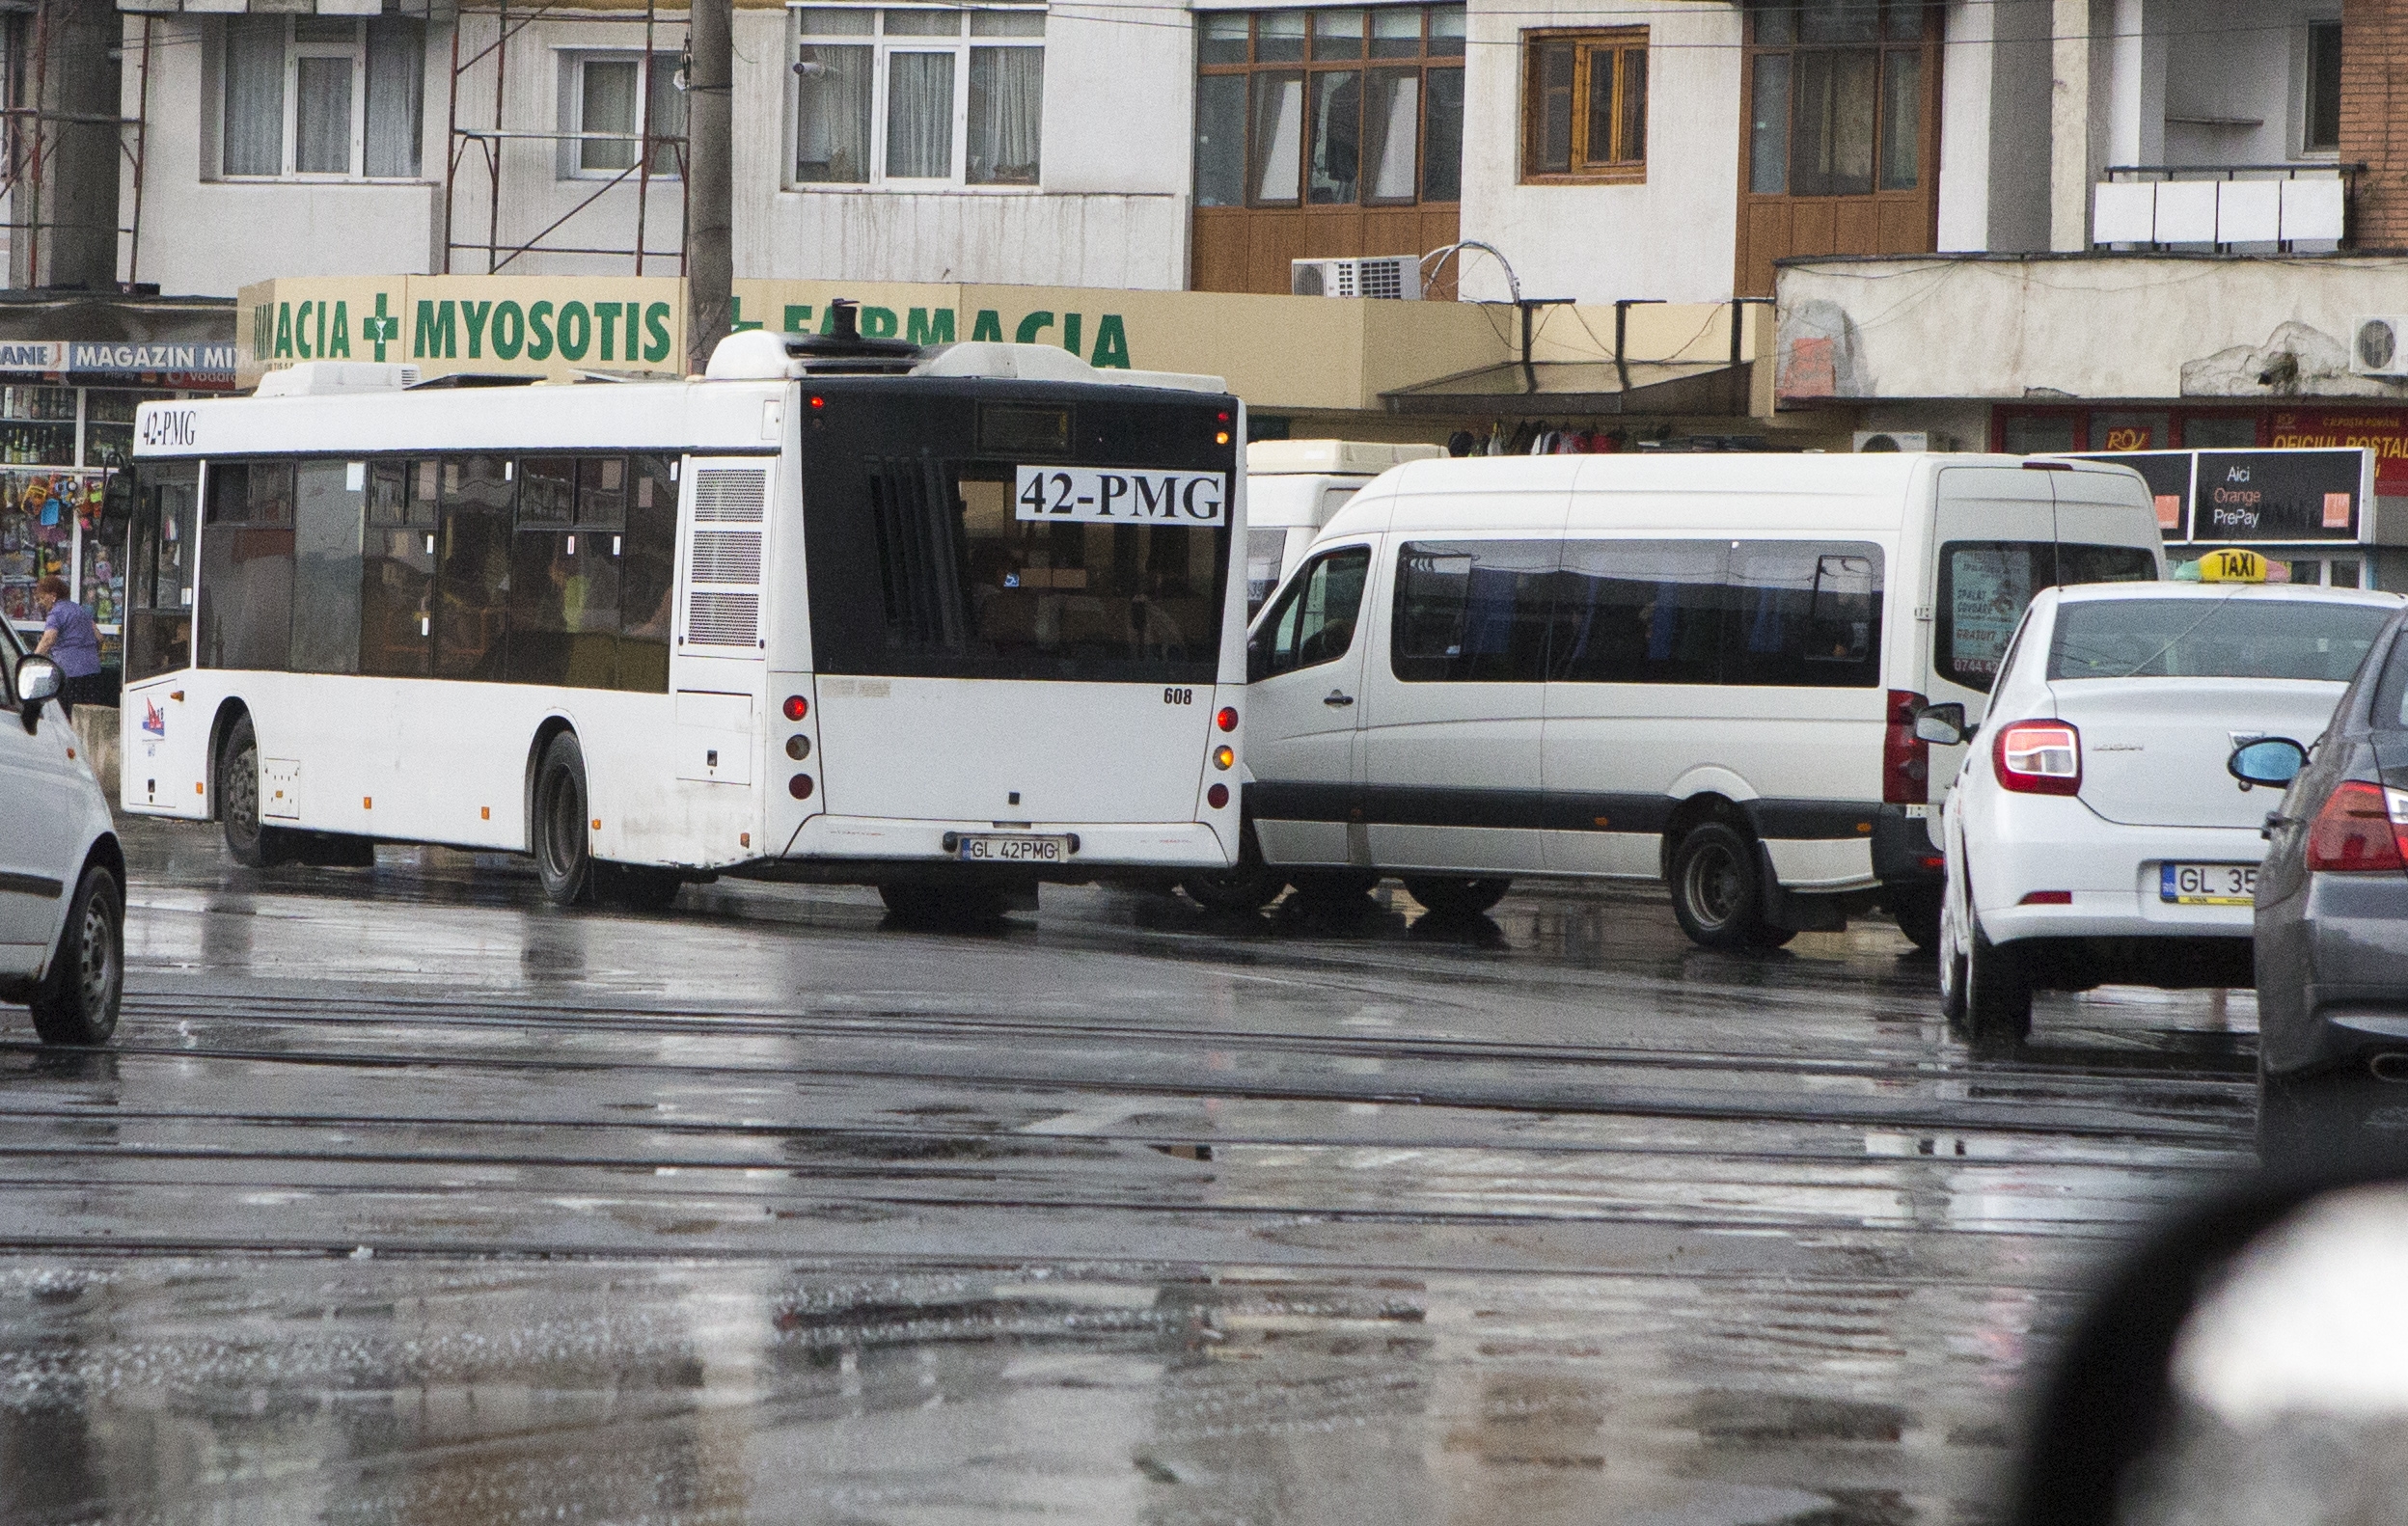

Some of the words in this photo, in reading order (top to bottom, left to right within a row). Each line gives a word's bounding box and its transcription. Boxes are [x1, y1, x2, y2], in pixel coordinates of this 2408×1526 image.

[414, 300, 671, 363] MYOSOTIS
[783, 305, 1132, 369] FRMACIA
[0, 346, 47, 366] ANE
[75, 345, 196, 368] MAGAZIN
[204, 347, 236, 368] MI
[143, 410, 197, 446] 42-PMG
[2227, 466, 2250, 481] Aici
[1020, 472, 1222, 520] 42-PMG
[2214, 487, 2261, 506] Orange
[2213, 508, 2259, 528] PrePay
[2218, 553, 2256, 577] TAXI
[1163, 687, 1192, 705] 608
[972, 841, 993, 858] GL
[1000, 841, 1054, 858] 42PMG
[2180, 868, 2215, 893] GL
